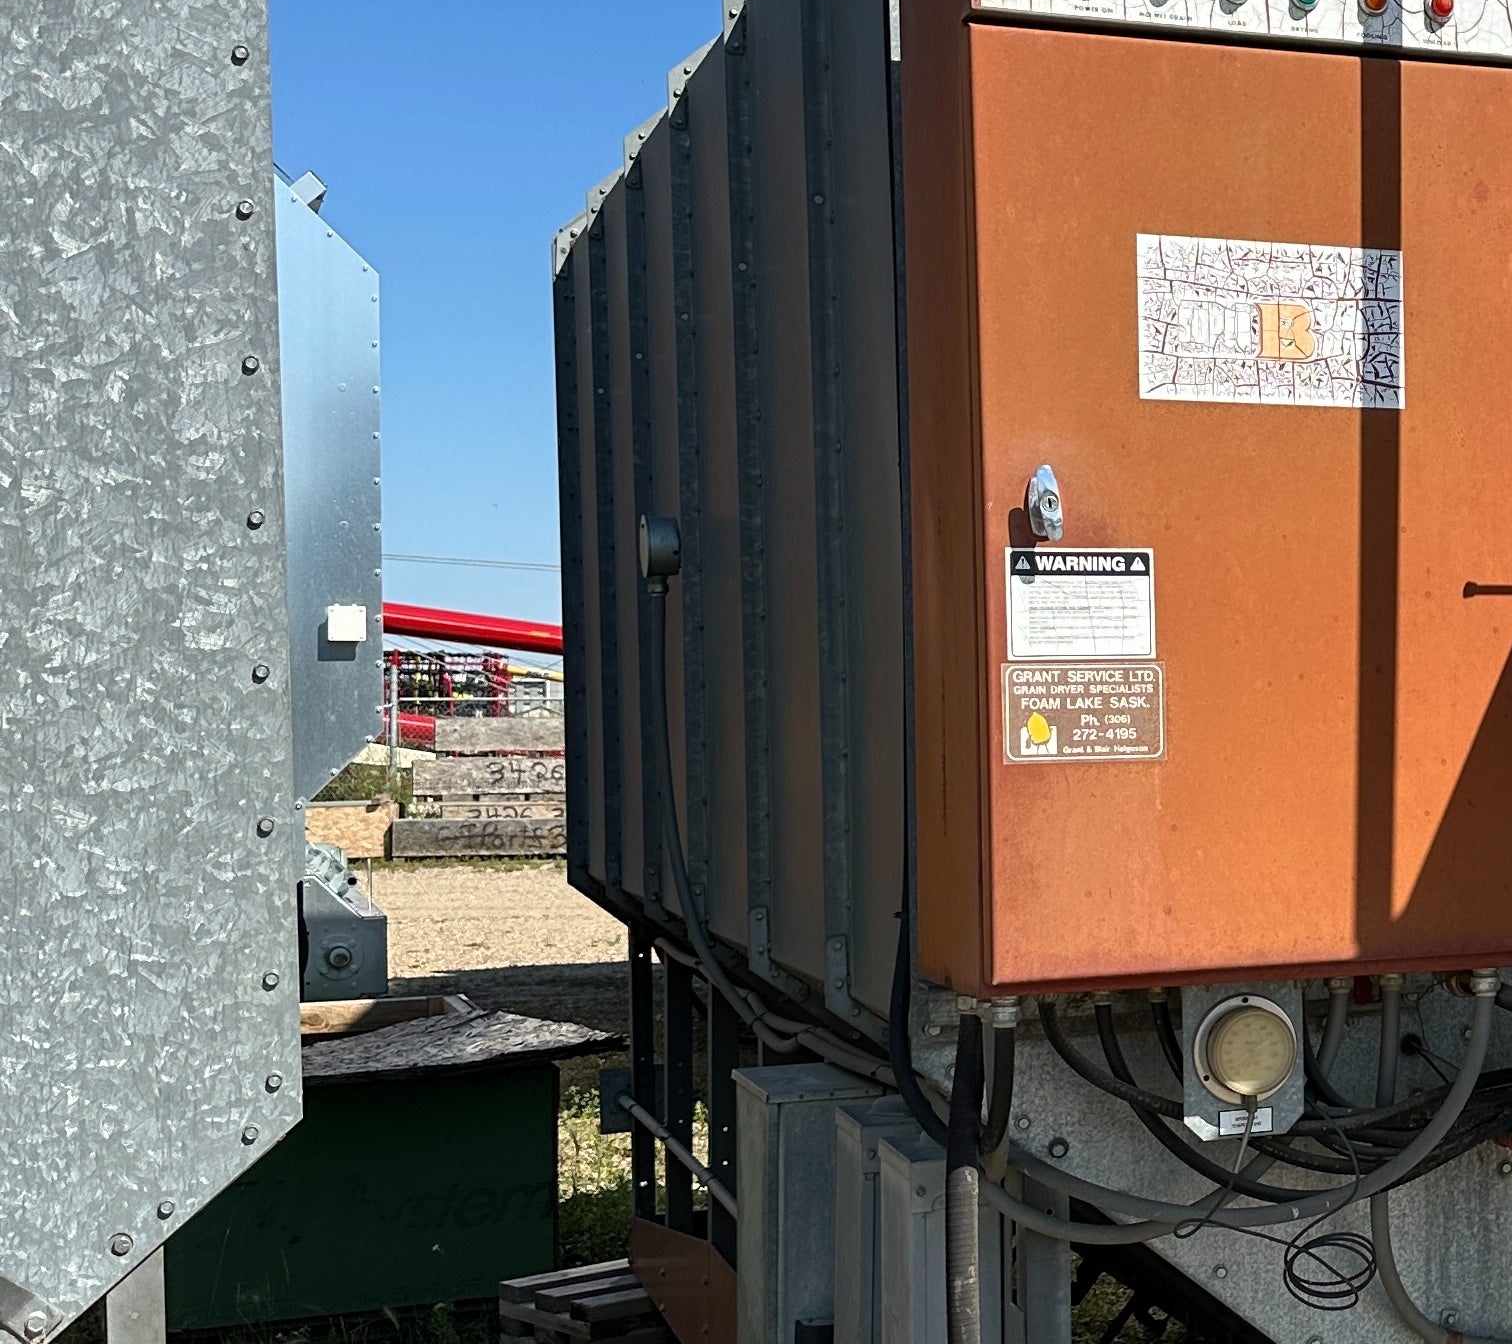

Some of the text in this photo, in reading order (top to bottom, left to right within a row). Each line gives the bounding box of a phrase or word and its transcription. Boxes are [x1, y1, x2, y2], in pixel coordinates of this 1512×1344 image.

[1034, 555, 1126, 572] WARNING
[1012, 670, 1156, 683] GRANT SERVICE LTD.
[1013, 684, 1154, 695] GRAIN DRYER SPECIALISTS
[1021, 696, 1151, 710] FOAM LAKE SASK.
[1104, 714, 1131, 725] (306)
[1072, 727, 1137, 741] 272-4195
